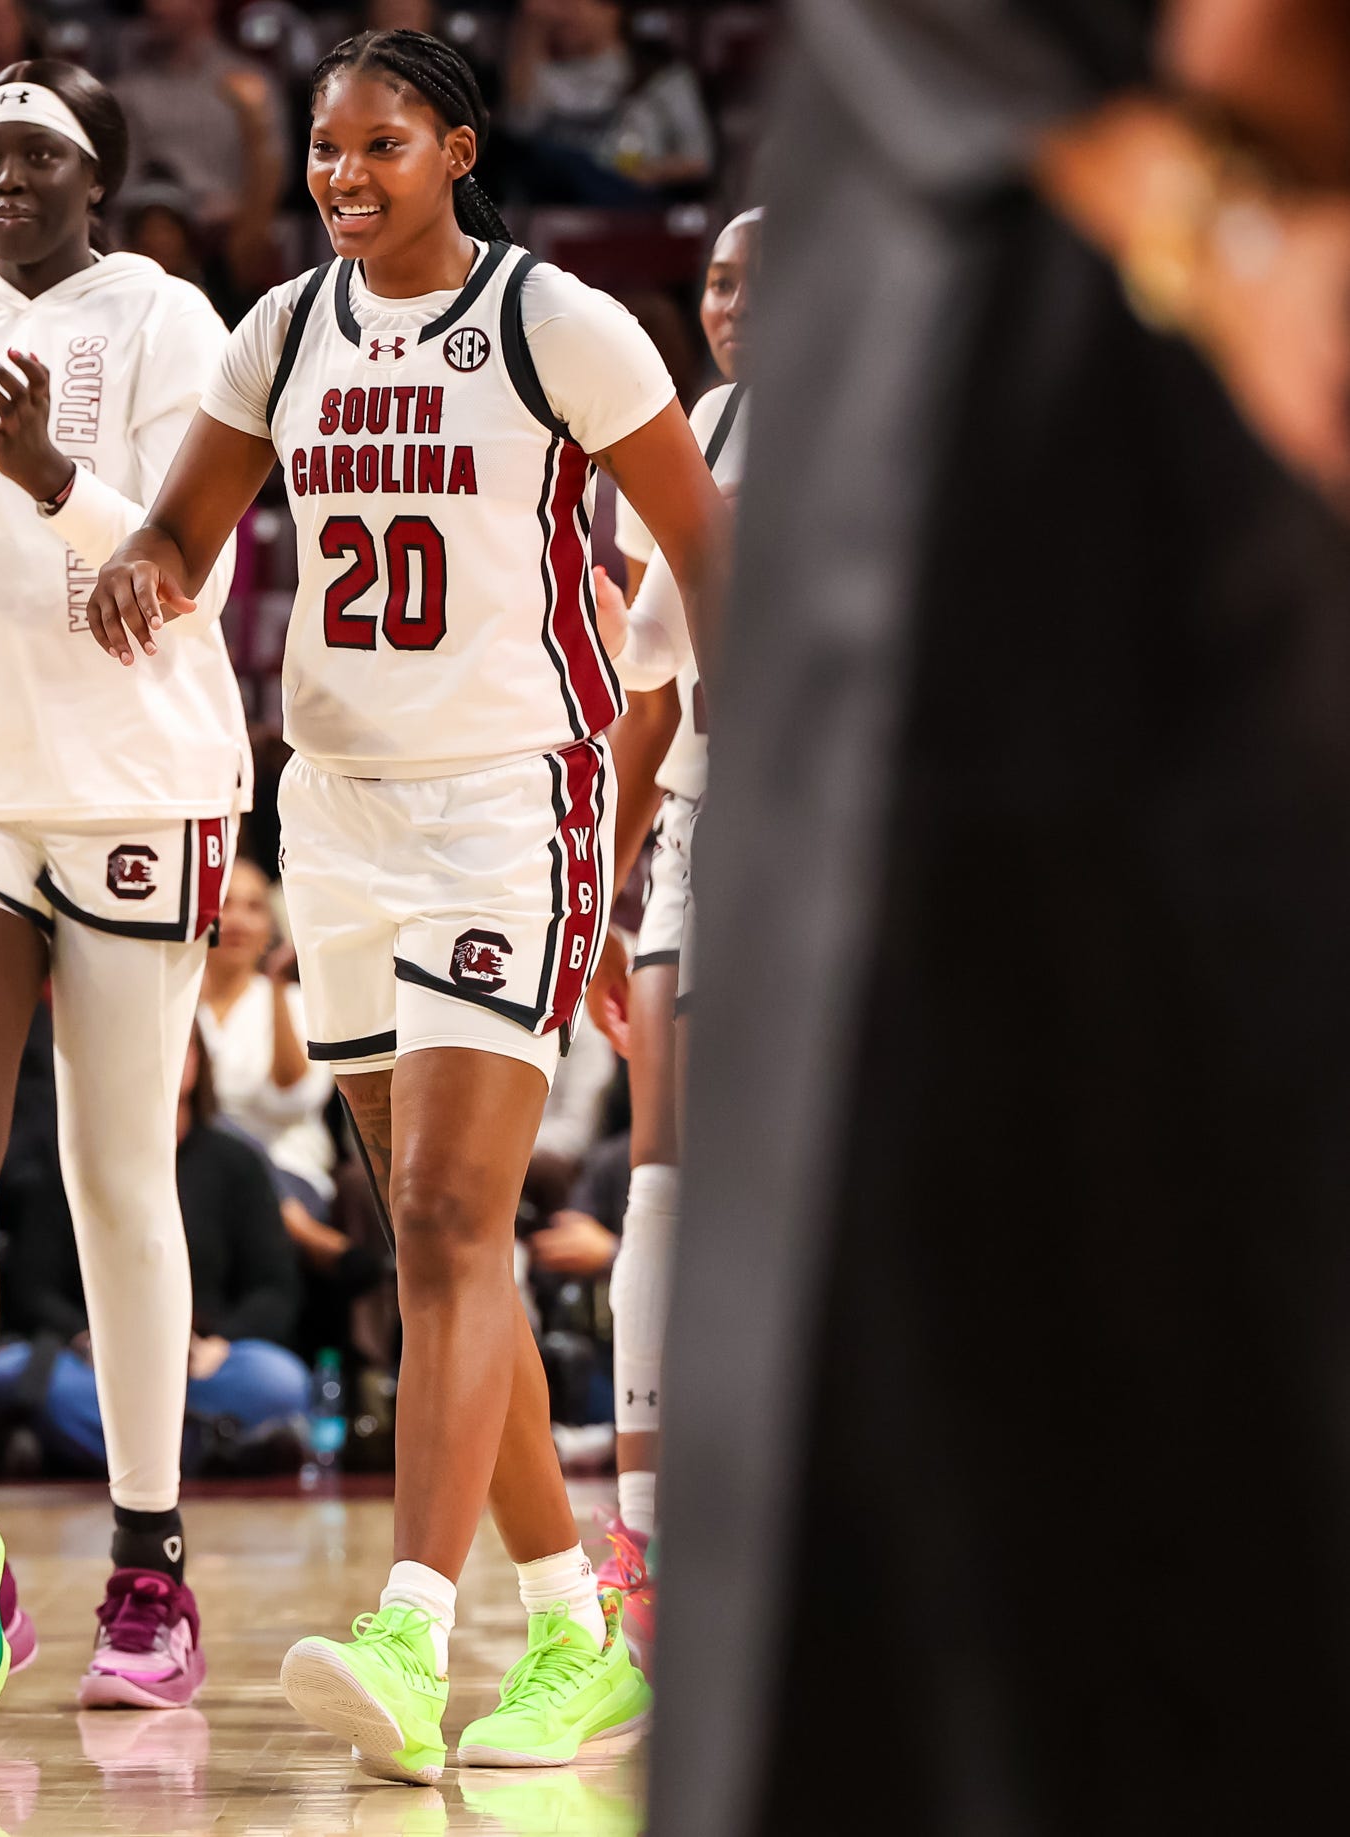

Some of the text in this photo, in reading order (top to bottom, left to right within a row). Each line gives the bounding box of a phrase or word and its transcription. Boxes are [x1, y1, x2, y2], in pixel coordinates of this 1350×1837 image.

[447, 330, 486, 369] SEC
[55, 336, 108, 443] SOUTH
[318, 386, 444, 436] SOUTH
[292, 444, 478, 497] CAROLINA
[319, 515, 447, 651] 20
[206, 835, 221, 868] B
